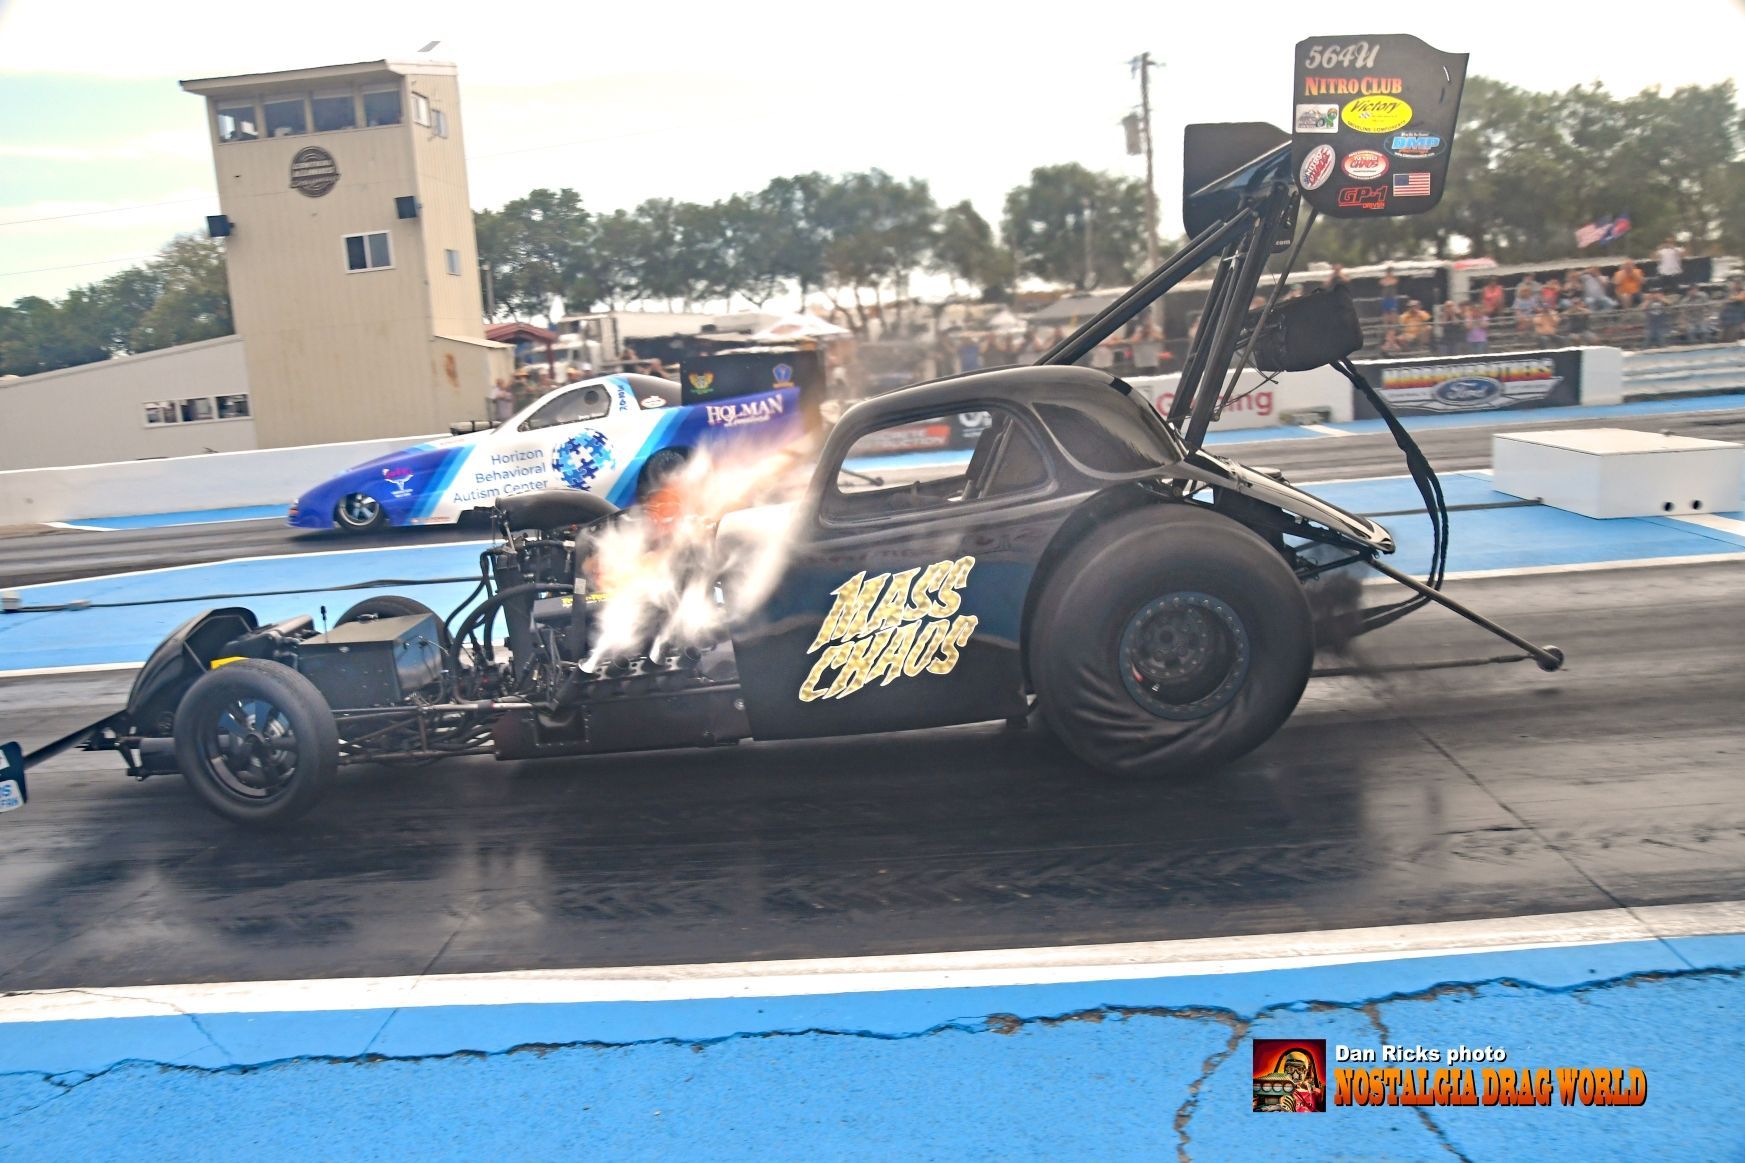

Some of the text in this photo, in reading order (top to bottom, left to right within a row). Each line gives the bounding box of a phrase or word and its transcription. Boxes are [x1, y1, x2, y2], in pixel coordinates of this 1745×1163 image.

[1350, 100, 1400, 114] Victory
[1444, 382, 1489, 400] Ford
[705, 394, 783, 426] HOLMAN
[491, 449, 544, 465] Horizon
[475, 463, 547, 484] Behavioral
[453, 480, 549, 503] Autism Center
[806, 555, 976, 655] MASS
[798, 614, 979, 703] CHAOS
